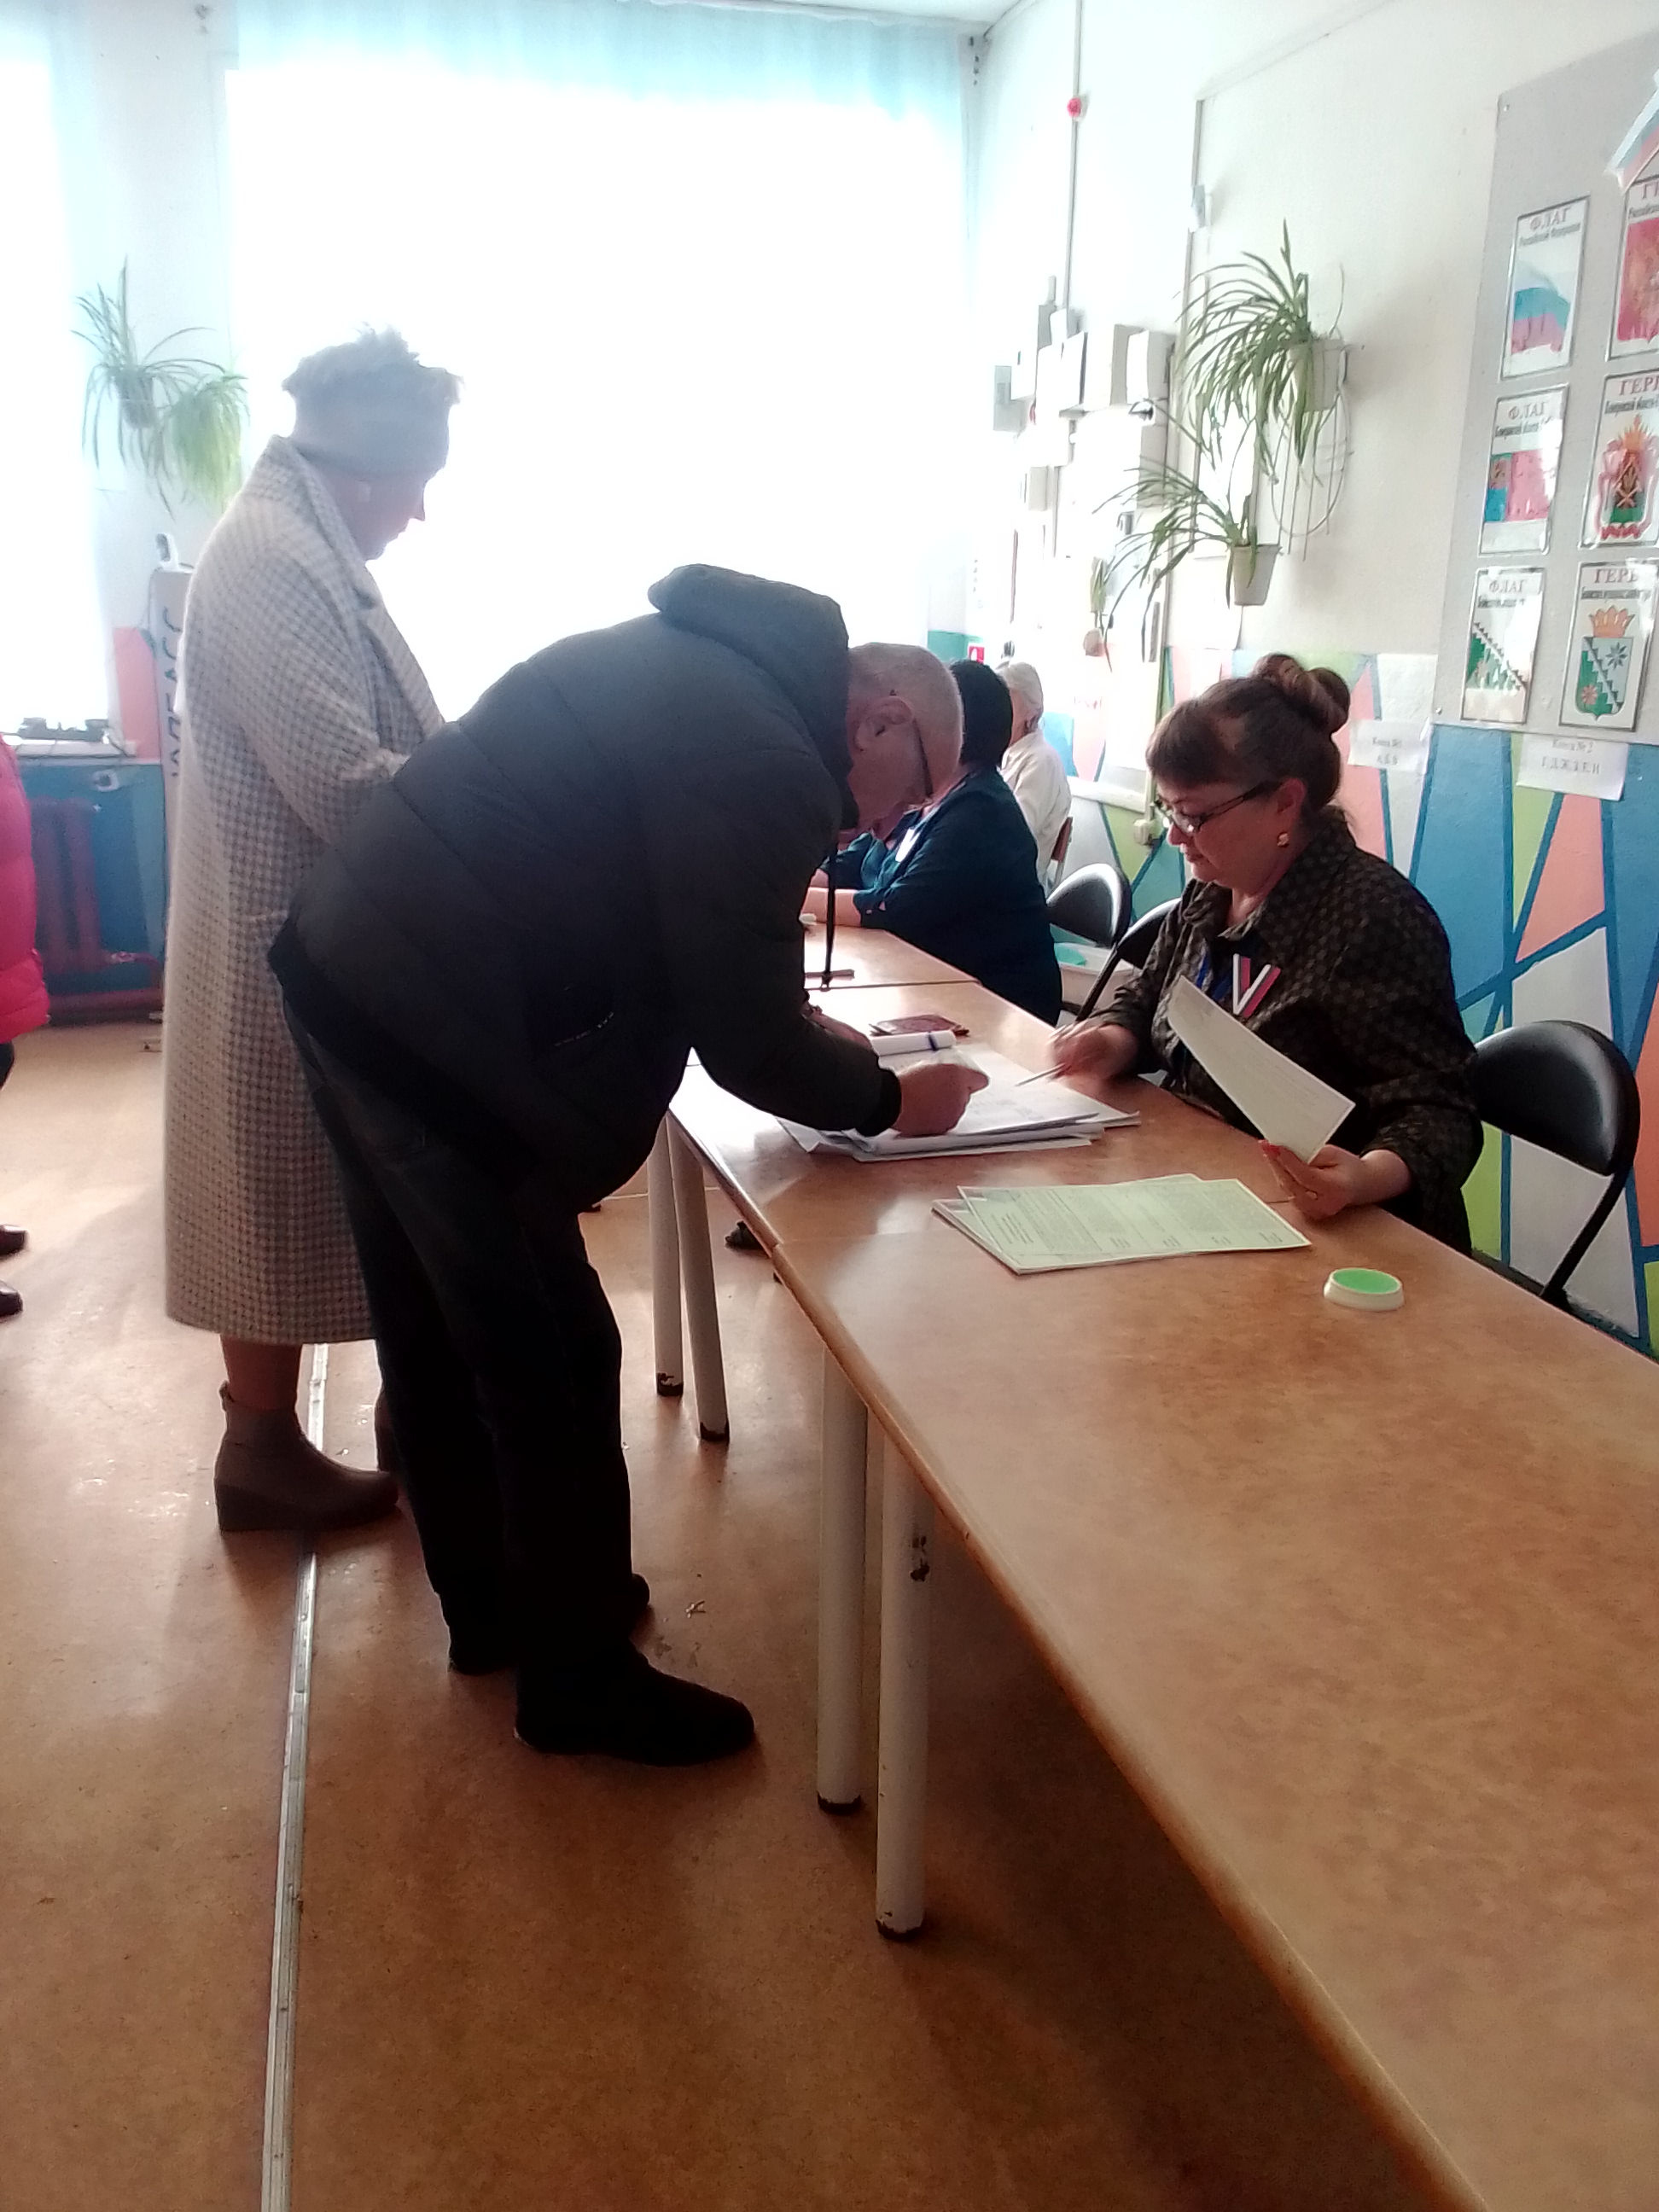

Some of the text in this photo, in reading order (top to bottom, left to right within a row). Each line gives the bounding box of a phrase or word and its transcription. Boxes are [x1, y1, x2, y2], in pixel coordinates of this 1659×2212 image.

[1529, 207, 1571, 230] ФЛАГ
[1508, 401, 1549, 420] ФЛАГ
[1489, 579, 1525, 593] ФЛАГ
